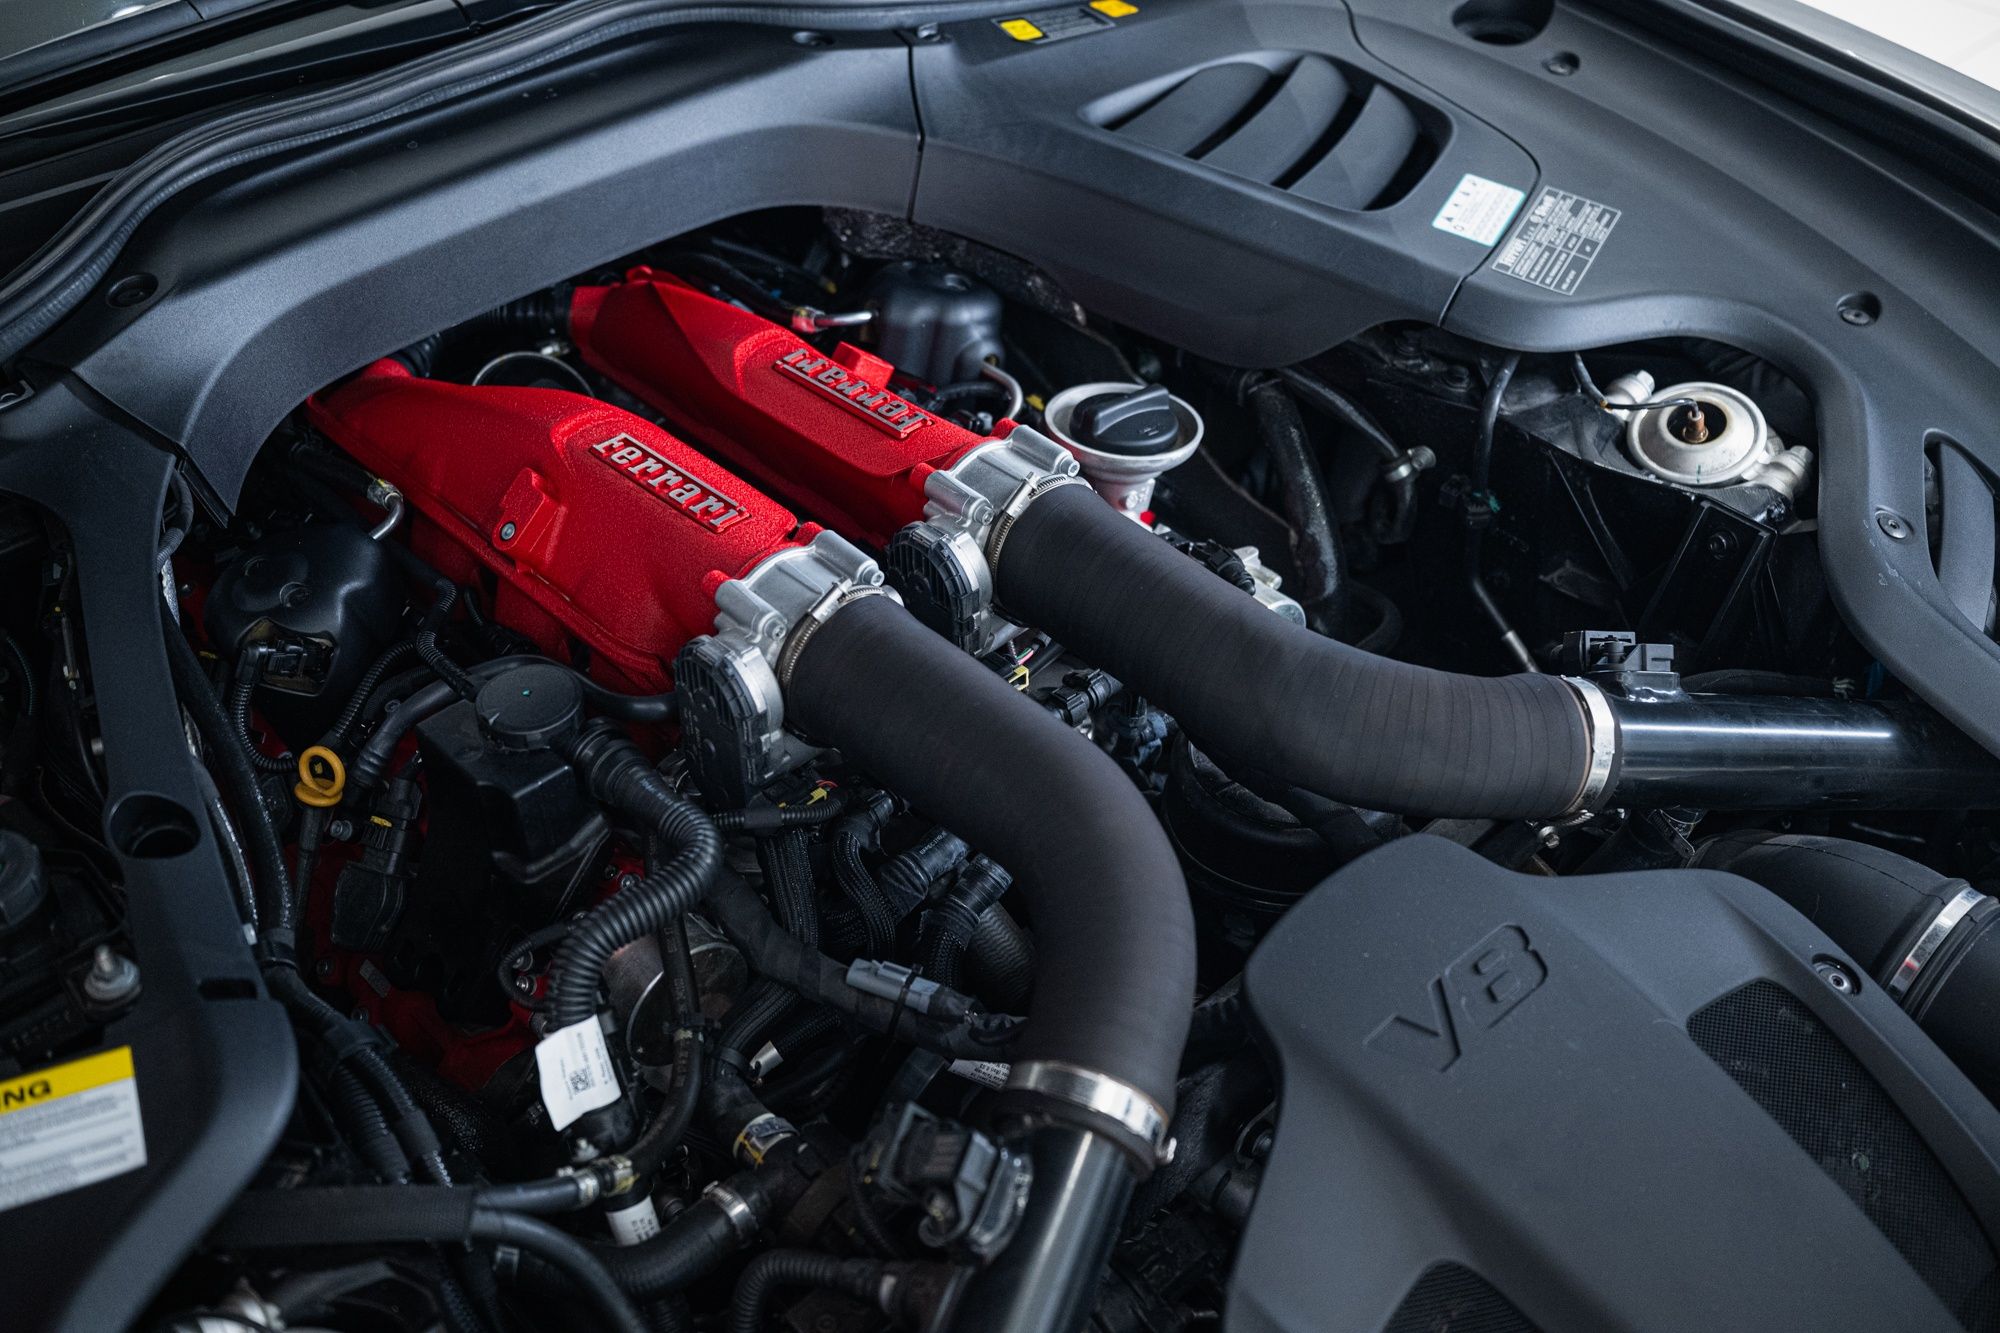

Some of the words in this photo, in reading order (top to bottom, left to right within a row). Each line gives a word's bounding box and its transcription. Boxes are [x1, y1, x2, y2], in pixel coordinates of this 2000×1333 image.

[775, 348, 934, 438] Ferrari
[592, 432, 750, 529] Ferrari
[1362, 923, 1549, 1073] V8
